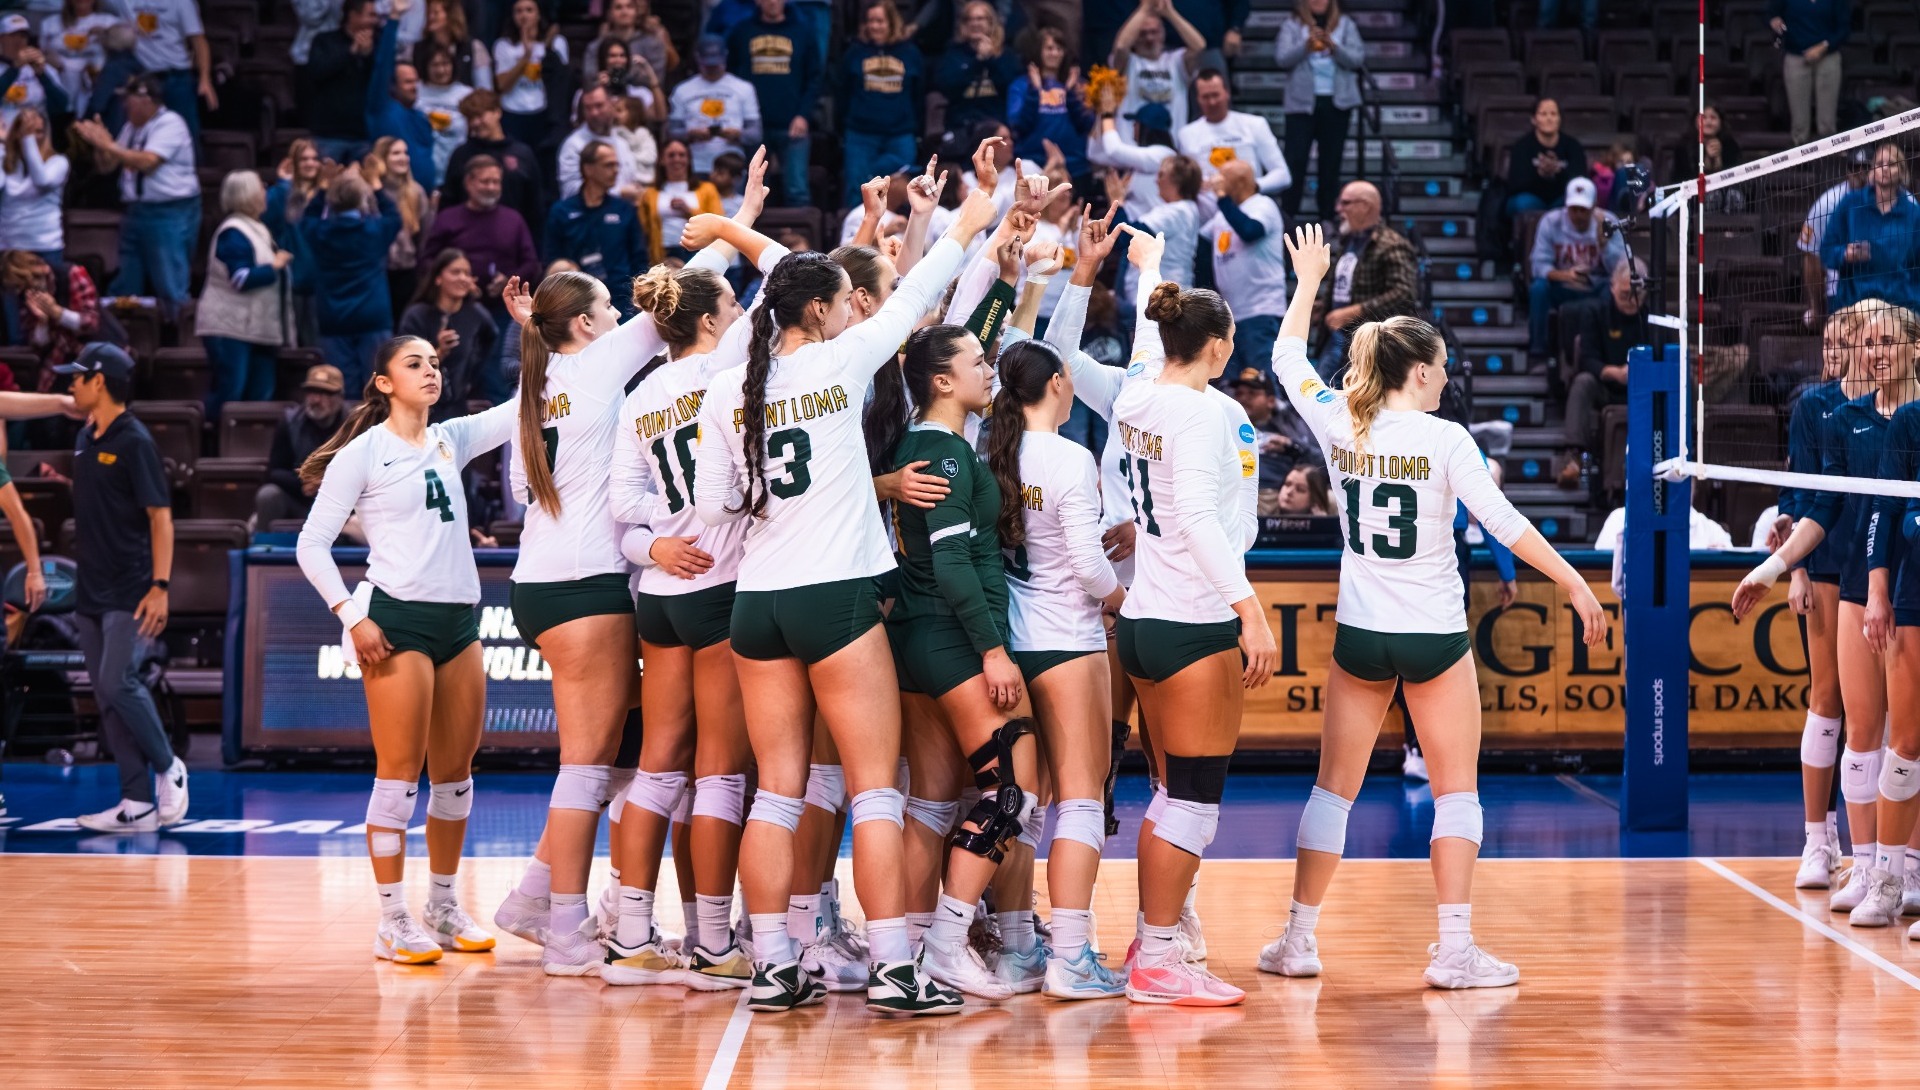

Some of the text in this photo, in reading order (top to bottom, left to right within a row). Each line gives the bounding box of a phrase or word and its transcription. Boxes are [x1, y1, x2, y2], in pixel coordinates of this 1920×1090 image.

[979, 298, 1003, 342] COMPETITIVE
[541, 392, 571, 423] OMA
[636, 407, 672, 442] POINT
[733, 385, 848, 434] PNT LOMA
[767, 427, 812, 500] 3
[1331, 444, 1431, 480] POINT LOMA
[424, 468, 455, 523] 4
[1341, 477, 1417, 560] 13
[1652, 678, 1664, 766] sports imports
